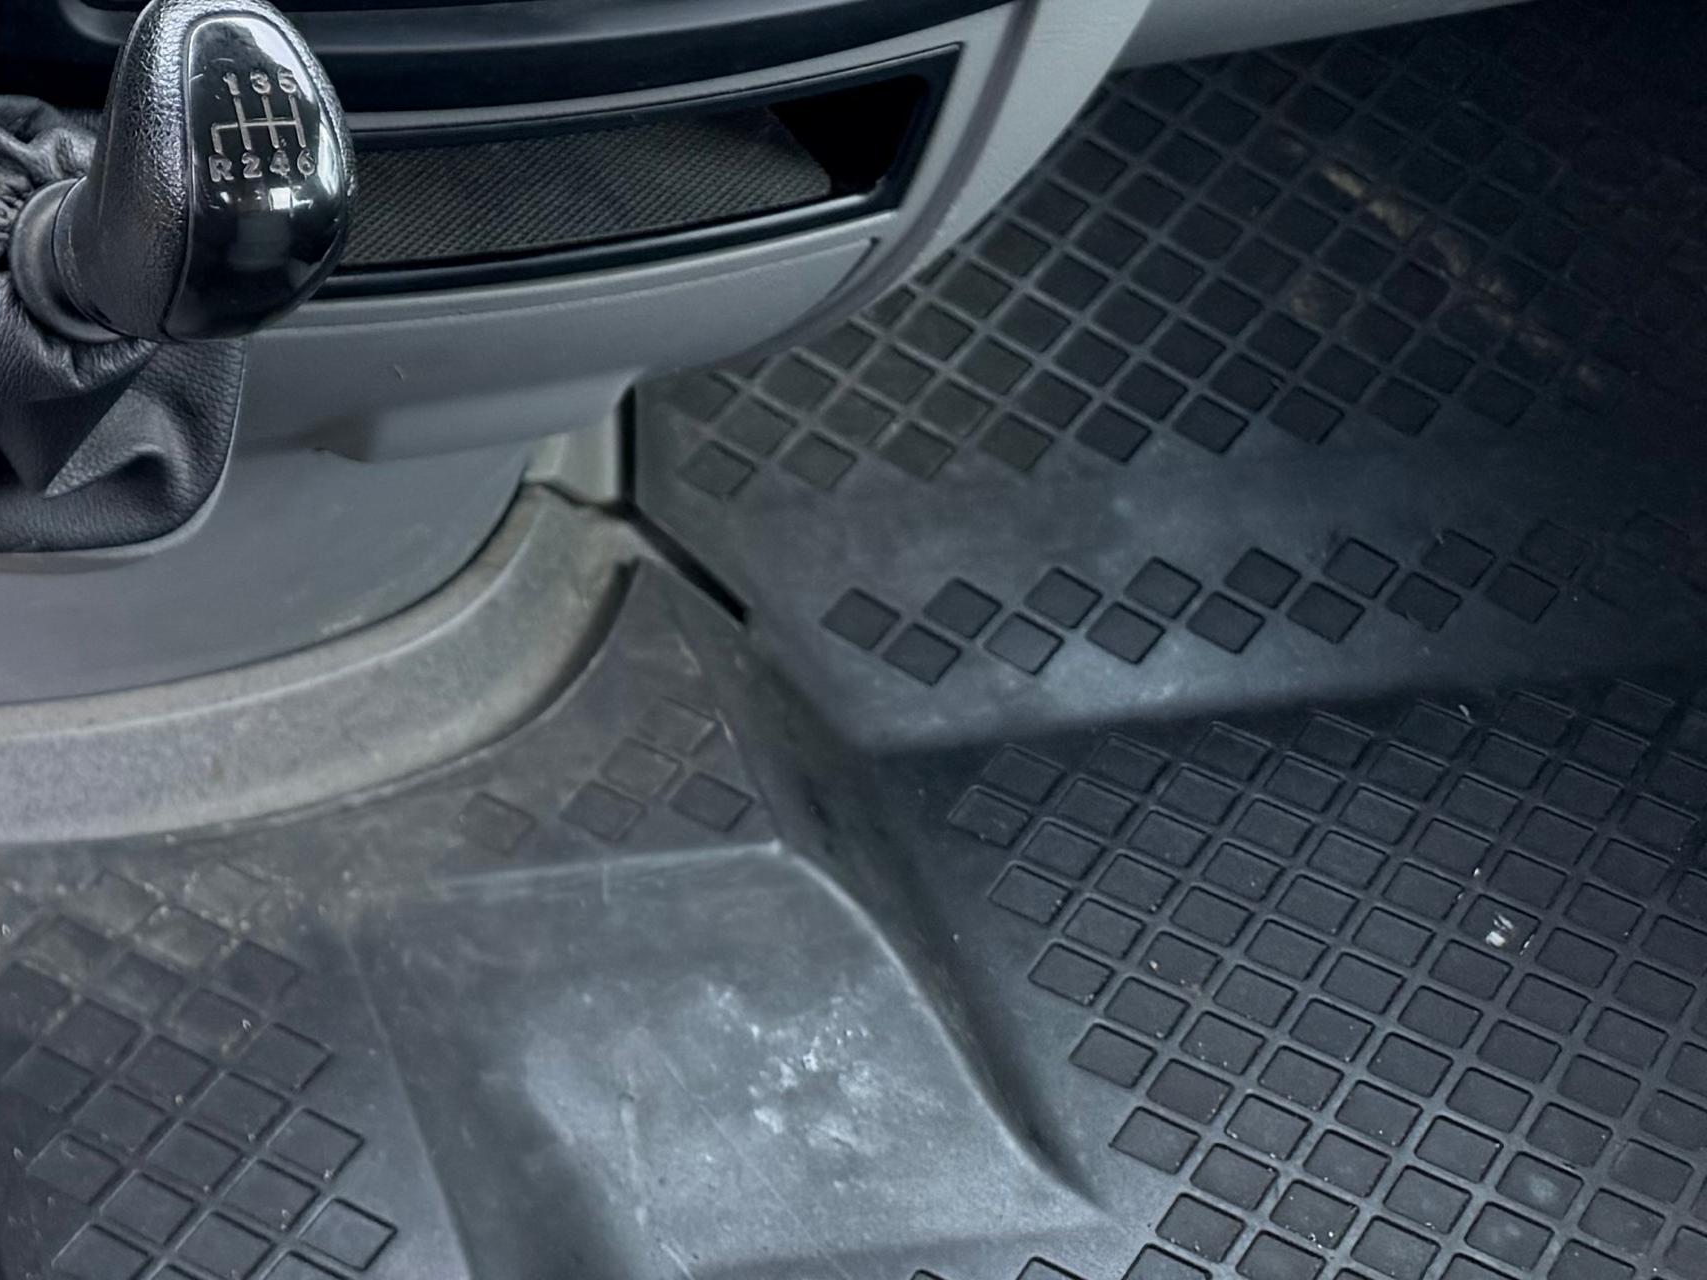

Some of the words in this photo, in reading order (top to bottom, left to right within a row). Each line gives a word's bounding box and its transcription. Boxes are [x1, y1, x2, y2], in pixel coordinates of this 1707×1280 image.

[222, 71, 241, 96] 1
[249, 70, 272, 94] 3
[277, 68, 299, 94] 5
[207, 153, 235, 183] R
[241, 151, 263, 179] 2
[269, 149, 291, 178] 4
[296, 149, 317, 178] 6
